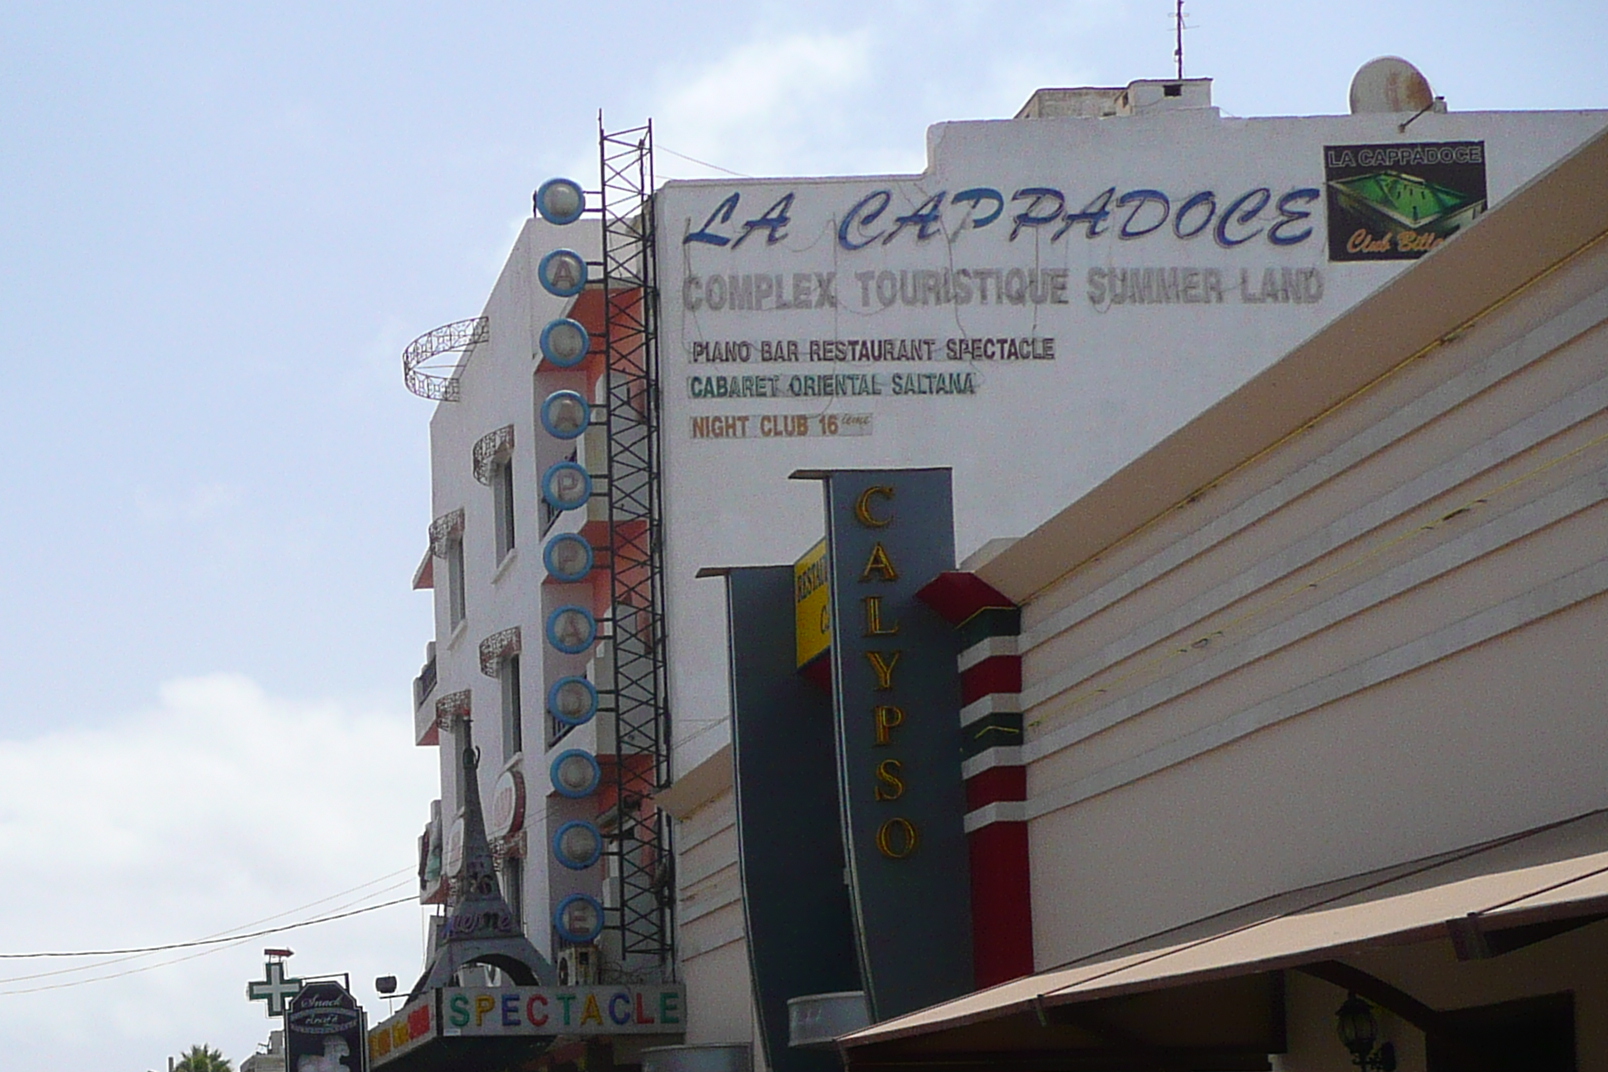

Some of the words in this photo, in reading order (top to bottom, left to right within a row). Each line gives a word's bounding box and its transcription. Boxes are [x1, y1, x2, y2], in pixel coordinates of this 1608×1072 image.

[1328, 151, 1355, 168] LA
[1358, 146, 1483, 167] CAPPADOCE
[683, 191, 795, 249] LA
[838, 186, 1321, 251] CAPPADOCE
[1347, 228, 1392, 253] Club
[683, 270, 838, 312] COMPLEX
[855, 267, 1070, 307] TOURISTIQUE
[1086, 266, 1224, 304] SUMMER
[1241, 265, 1325, 304] LAND
[692, 340, 751, 362] PIANO
[760, 339, 800, 361] BAR
[809, 338, 935, 361] RESTAURANT
[946, 337, 1056, 360] SPECTACLE
[691, 375, 780, 398] CABARET
[790, 374, 882, 397] ORIENTAL
[892, 372, 976, 395] SALTANA
[692, 414, 750, 438] NIGHT
[759, 414, 809, 436] CLUB
[856, 485, 919, 859] CALYPSO
[449, 992, 681, 1027] SPECTACLE
